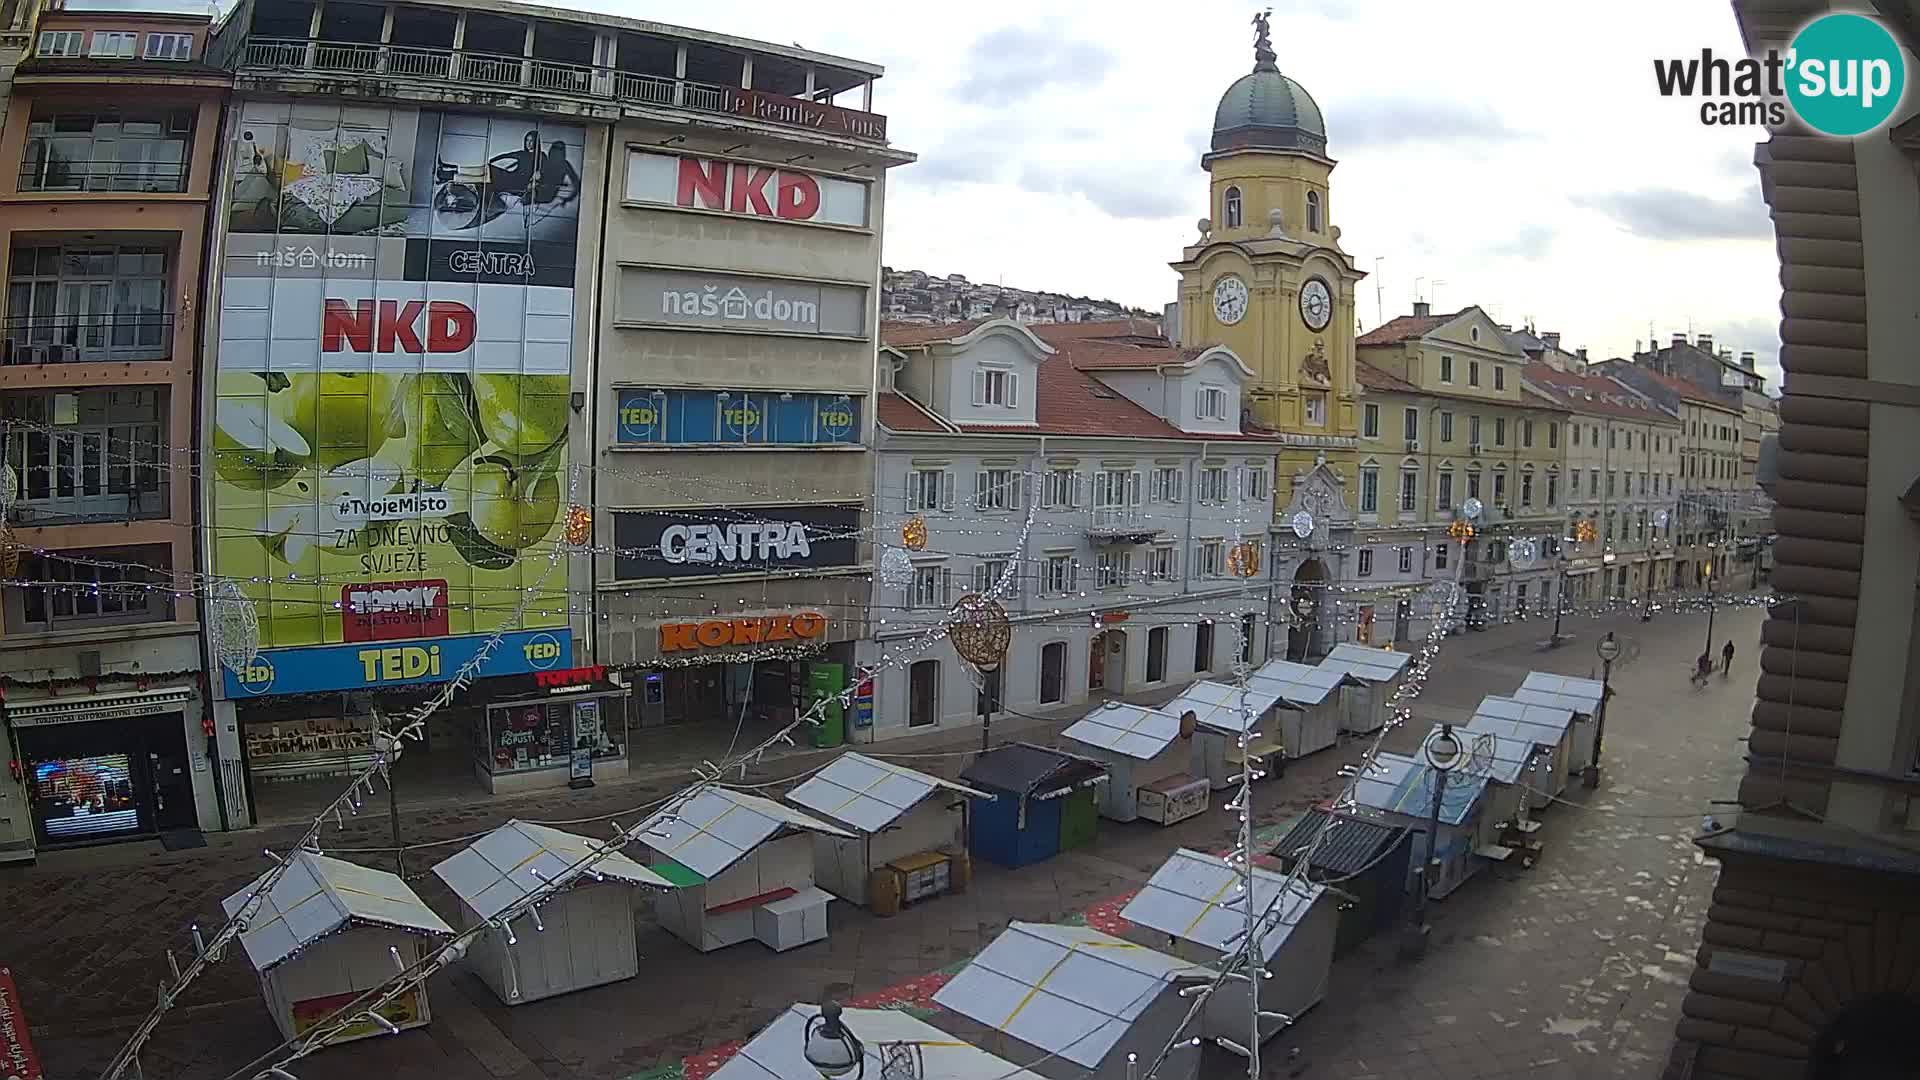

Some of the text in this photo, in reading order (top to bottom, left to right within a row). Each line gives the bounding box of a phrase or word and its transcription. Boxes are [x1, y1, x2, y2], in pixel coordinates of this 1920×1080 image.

[723, 89, 746, 113] Le
[677, 158, 821, 220] NKD
[257, 246, 296, 268] naš
[450, 250, 536, 277] CENTRA
[662, 283, 817, 324] naš dom
[322, 298, 478, 354] NKD
[620, 408, 658, 425] TEDi
[724, 408, 760, 425] TEDi
[820, 410, 853, 427] TEDi
[339, 496, 447, 516] #TvojeMisto
[334, 524, 451, 549] ZA DNEVNO
[660, 521, 811, 564] CENTRA
[360, 546, 428, 575] SVJEŽE
[350, 586, 440, 614] TOMMY
[659, 612, 827, 652] KORZO
[358, 645, 441, 682] TEDi
[523, 643, 561, 659] TEDi
[536, 666, 605, 687] TOMMY
